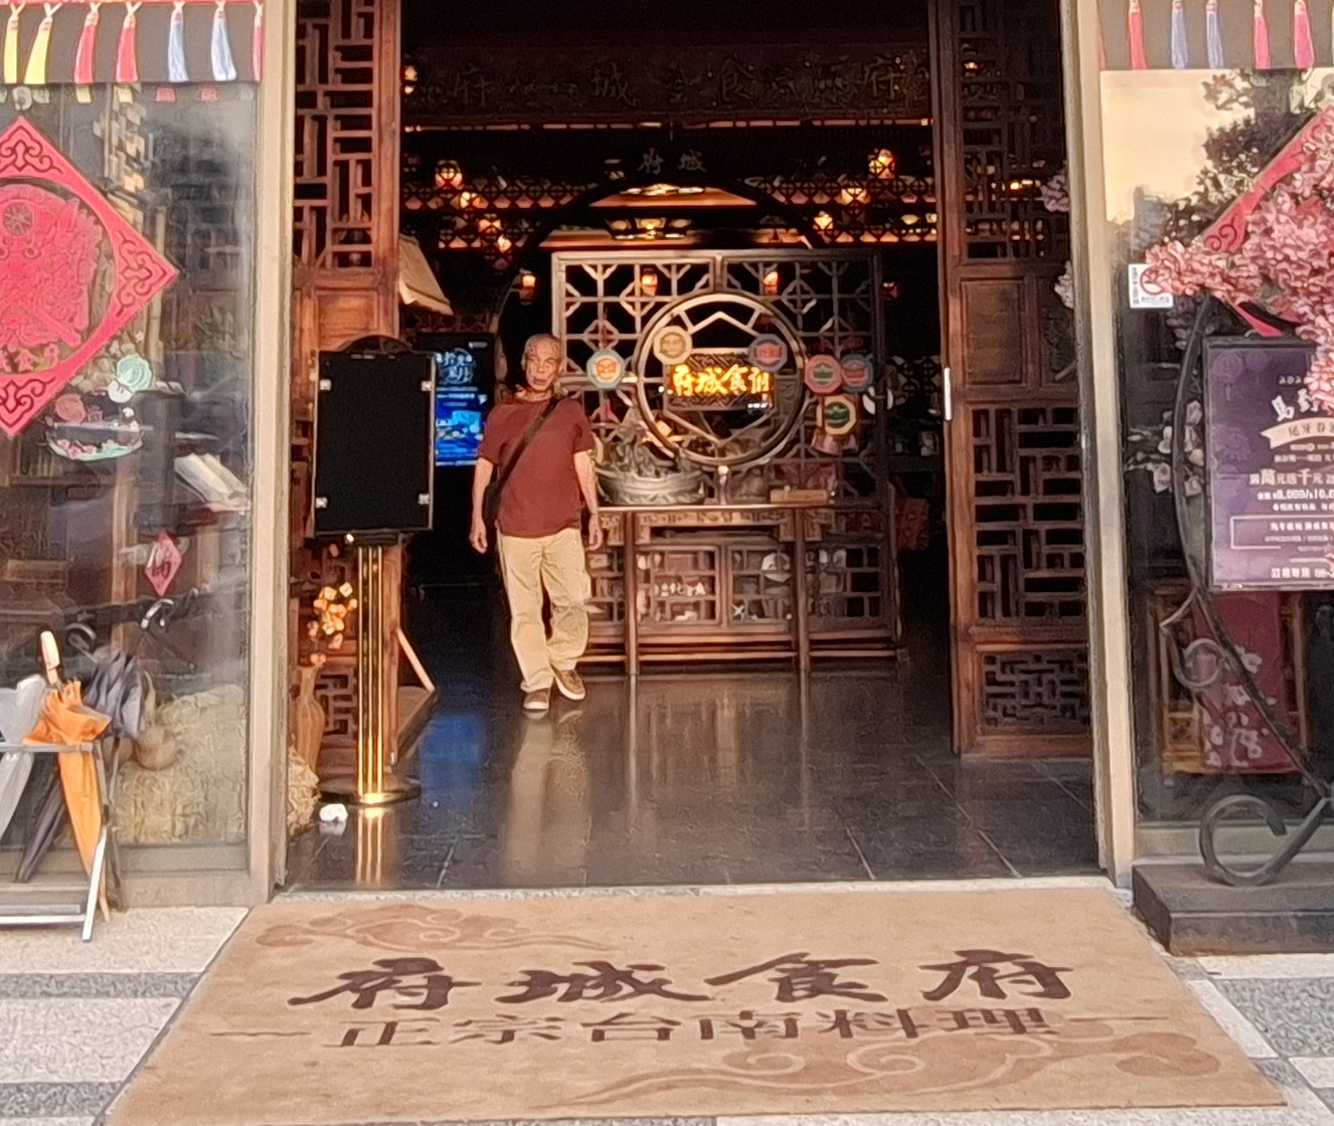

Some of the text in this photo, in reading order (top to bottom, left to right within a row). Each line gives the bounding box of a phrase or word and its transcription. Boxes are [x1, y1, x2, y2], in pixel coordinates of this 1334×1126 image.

[287, 949, 1074, 1011] 府城食府
[322, 1006, 1061, 1048] 正宗台南料理
